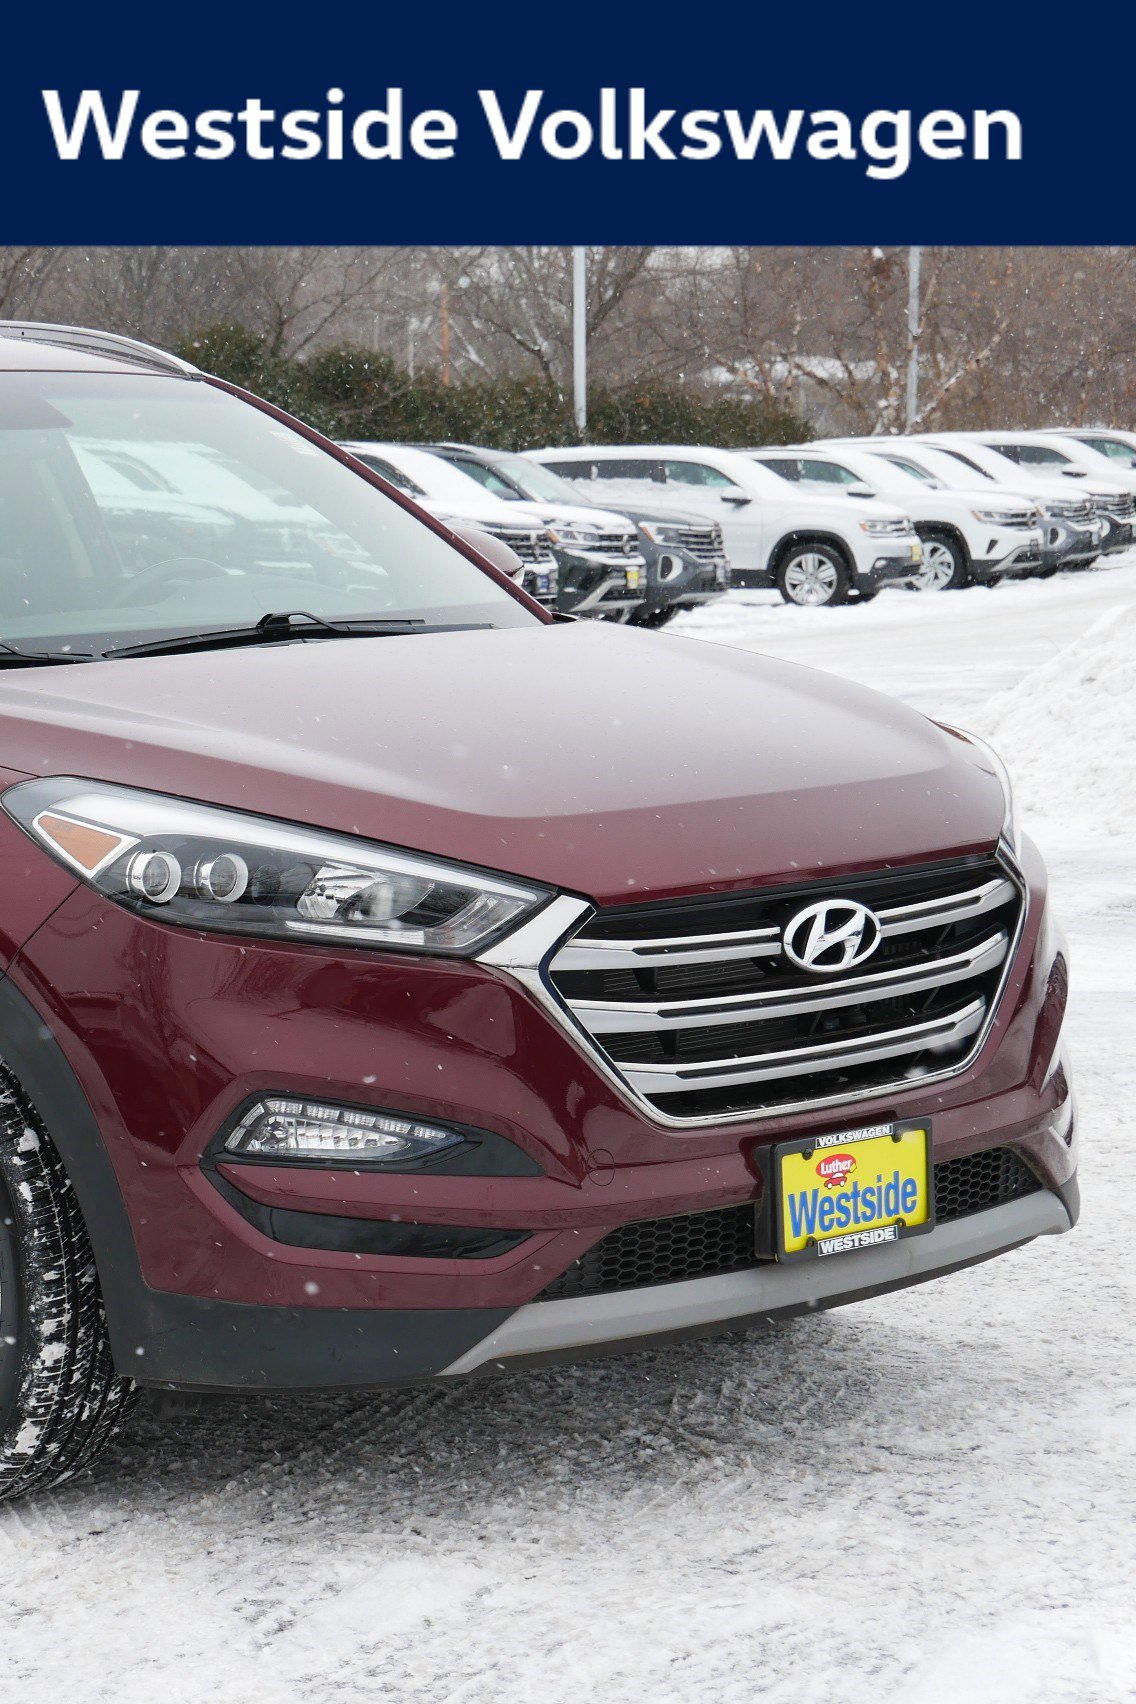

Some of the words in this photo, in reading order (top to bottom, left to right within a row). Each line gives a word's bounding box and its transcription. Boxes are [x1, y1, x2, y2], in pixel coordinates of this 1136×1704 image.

[817, 1123, 891, 1148] VOLKSWAGEN
[820, 1160, 853, 1175] Luther
[787, 1170, 918, 1239] Westside
[819, 1226, 897, 1254] WESTSIDE
